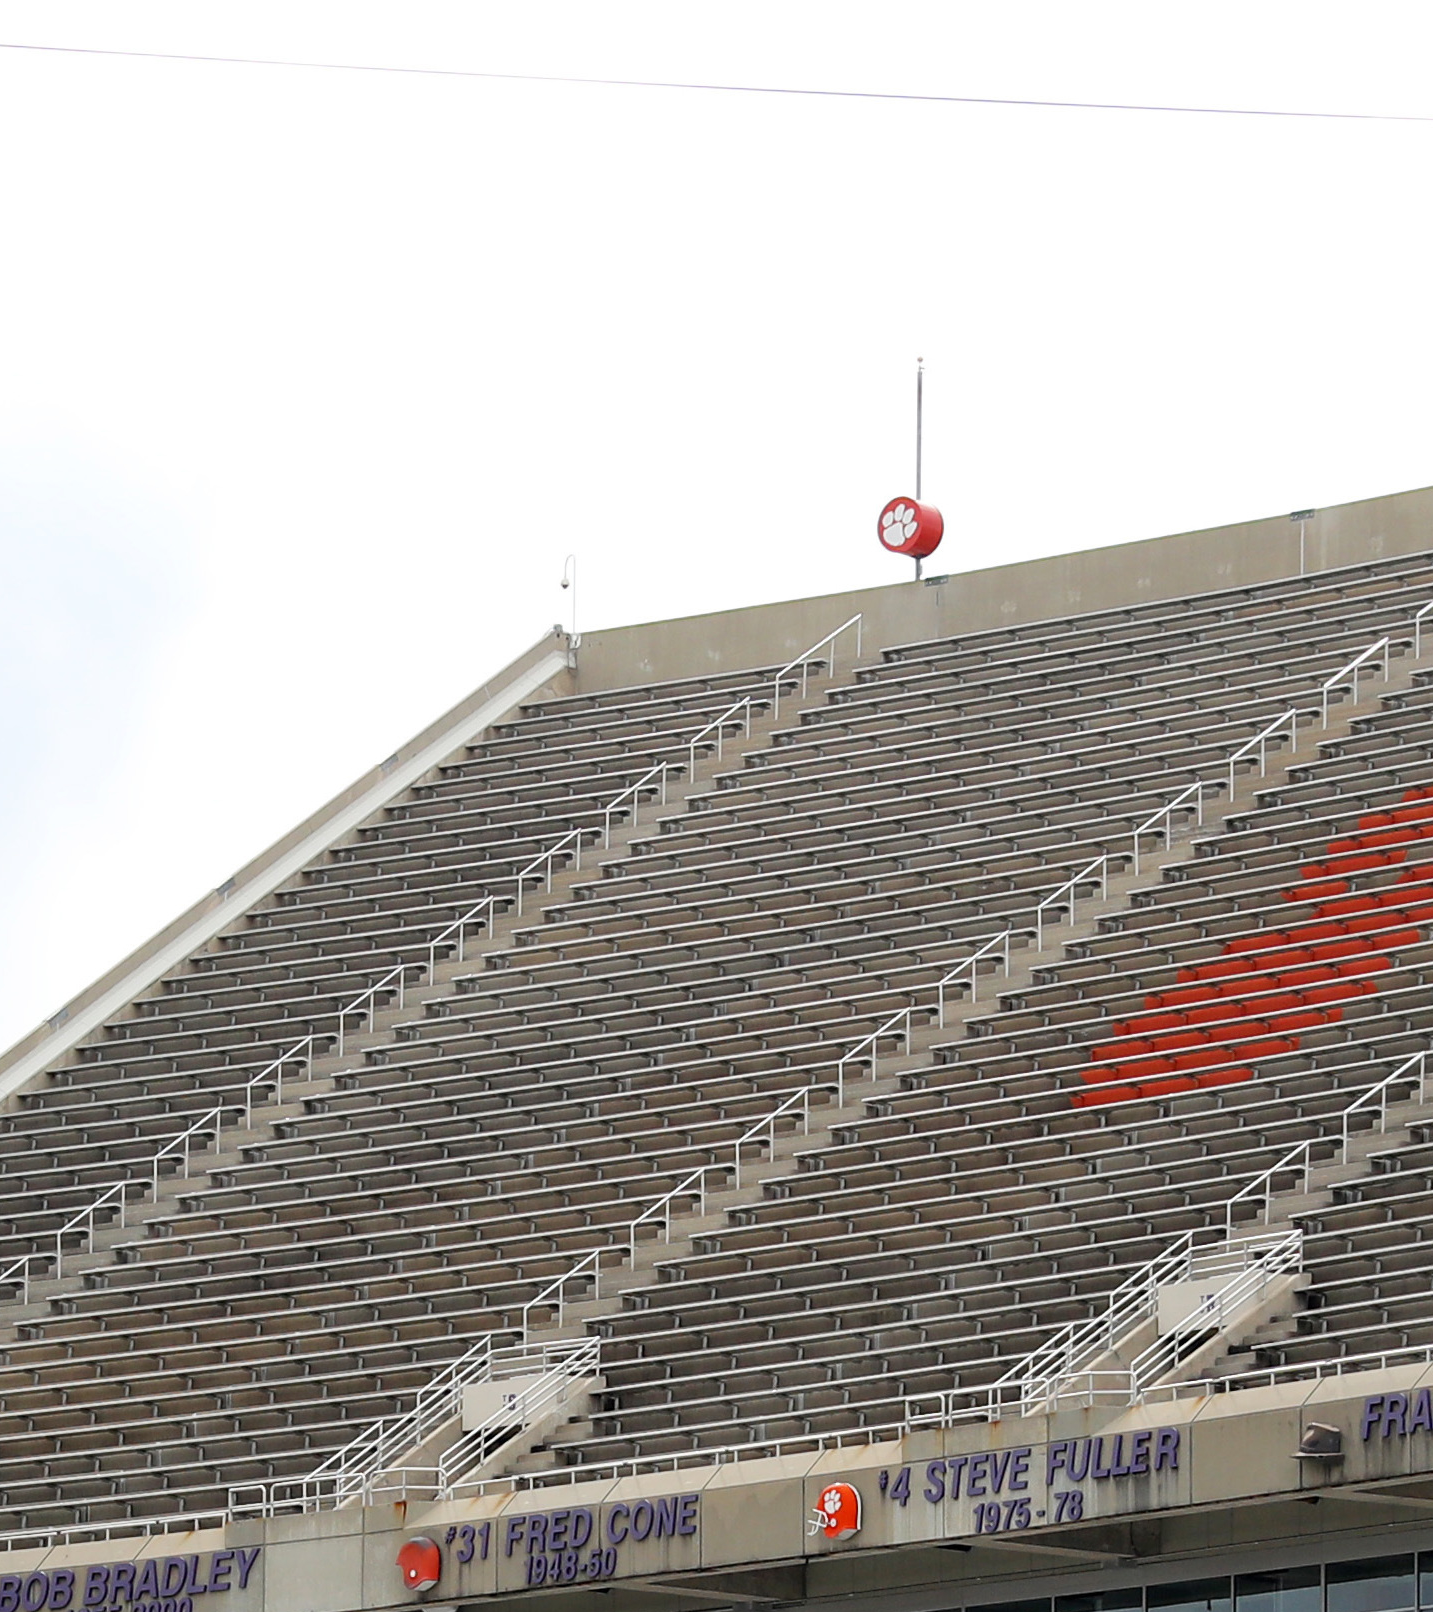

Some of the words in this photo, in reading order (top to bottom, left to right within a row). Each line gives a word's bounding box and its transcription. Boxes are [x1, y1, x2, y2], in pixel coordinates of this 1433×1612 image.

[878, 1467, 912, 1507] #4
[923, 1448, 1032, 1504] STEVE
[1046, 1427, 1181, 1486] FULLER
[445, 1522, 491, 1564] #31
[505, 1508, 593, 1557] FRED
[606, 1494, 699, 1545] CONE
[84, 1548, 262, 1606] BRADLEY
